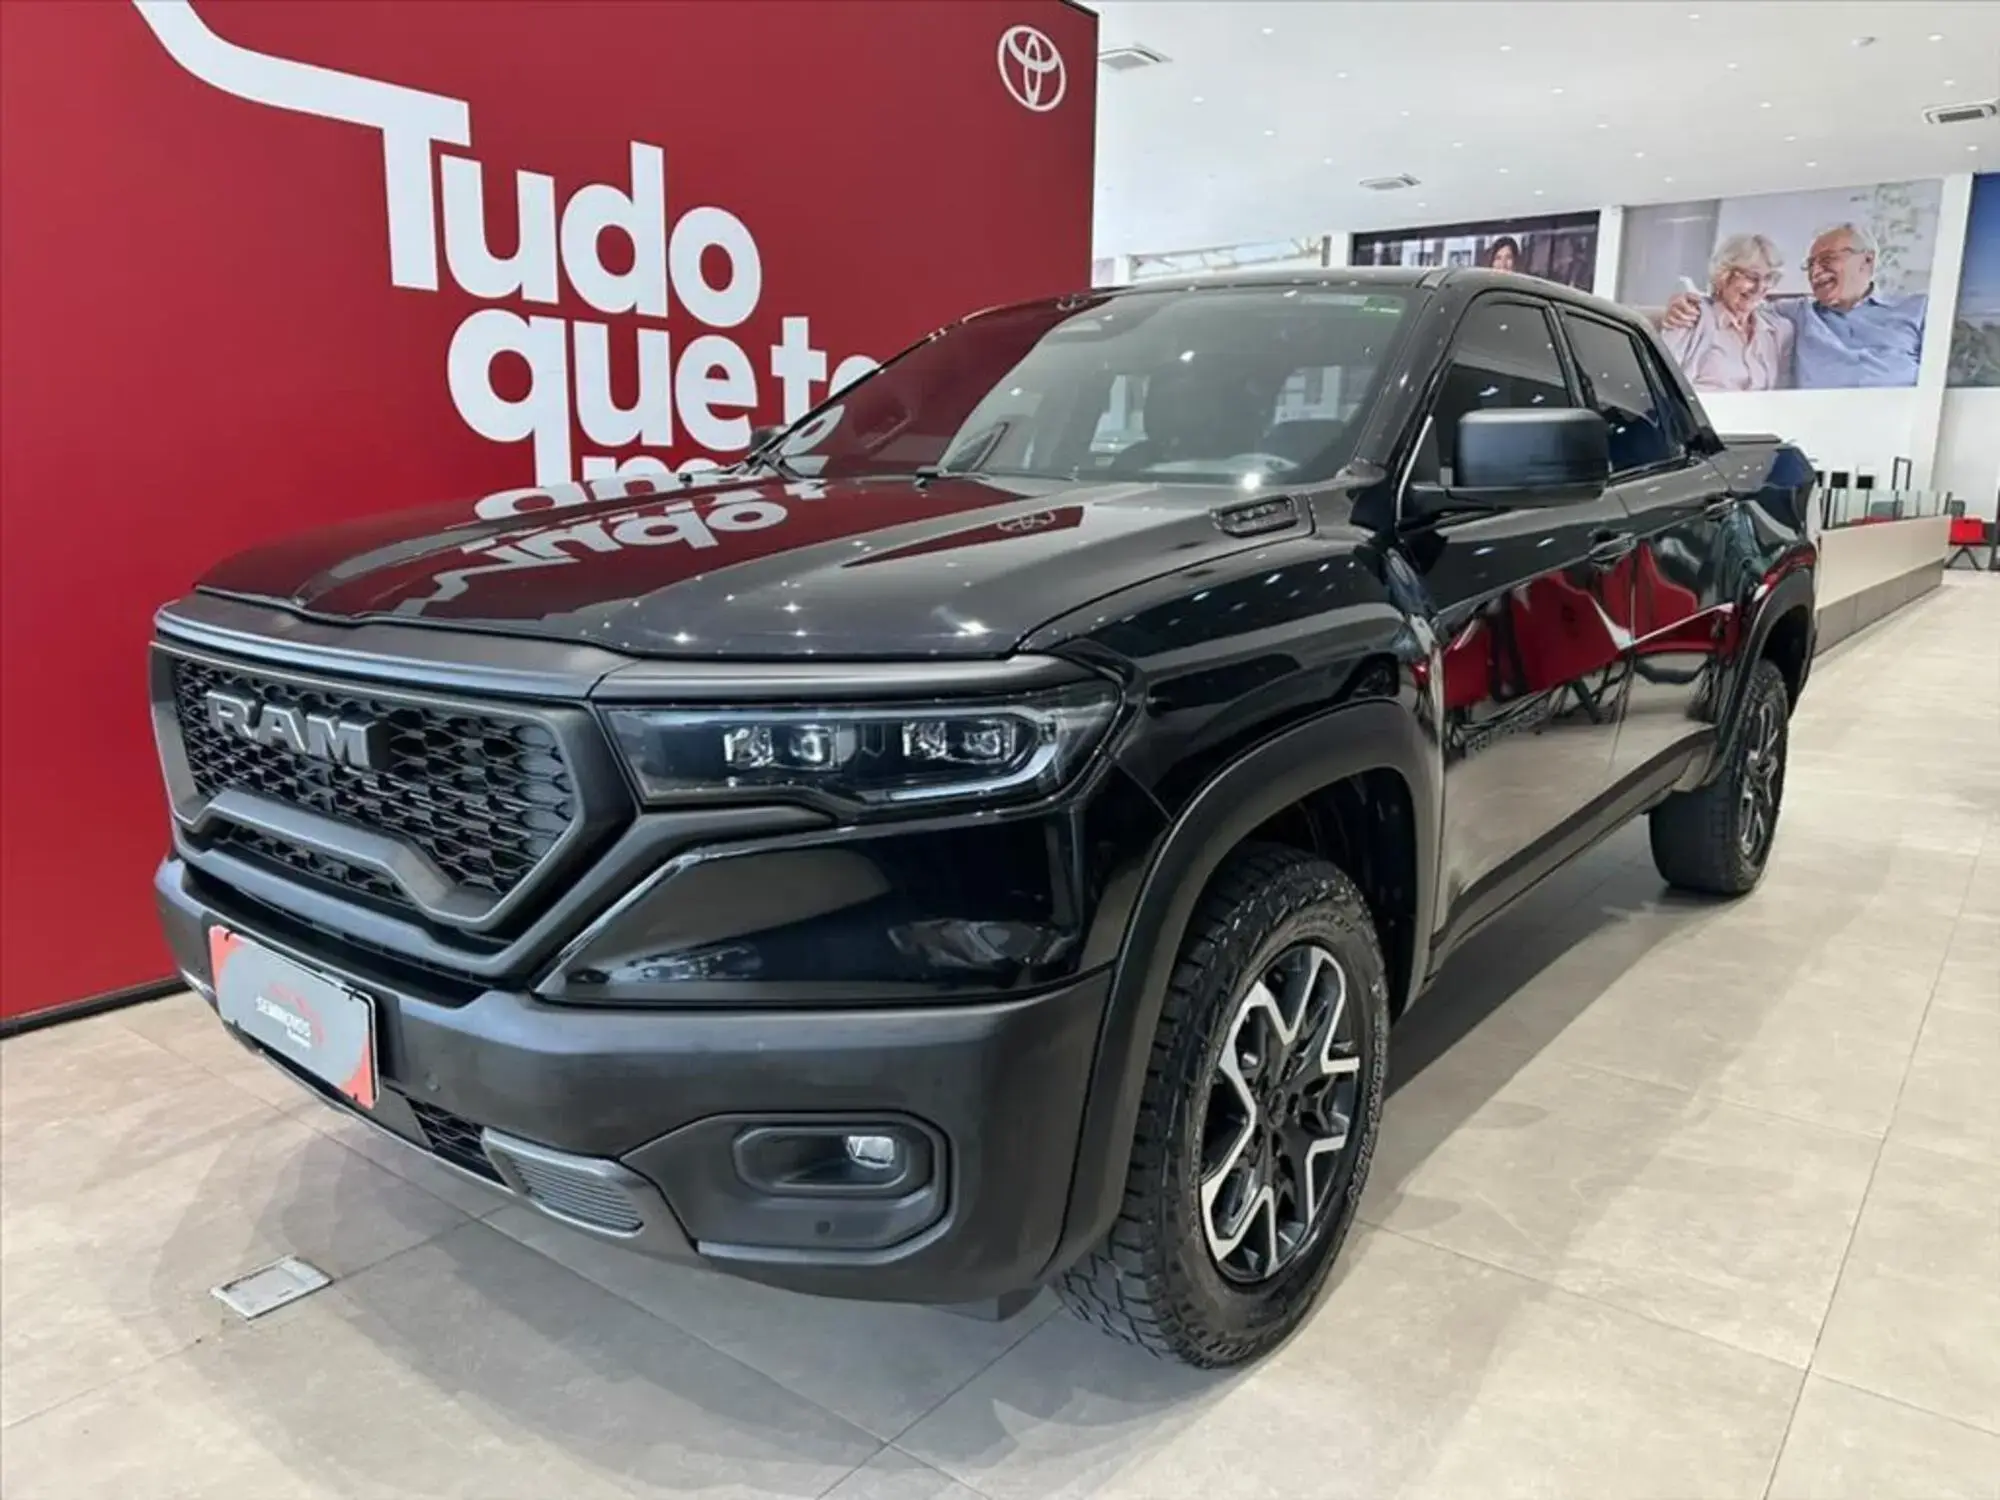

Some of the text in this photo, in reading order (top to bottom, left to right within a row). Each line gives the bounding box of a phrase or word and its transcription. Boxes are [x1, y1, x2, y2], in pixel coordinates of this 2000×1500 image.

[290, 62, 762, 328] Tudo
[447, 307, 758, 488] que
[206, 690, 372, 769] RAM
